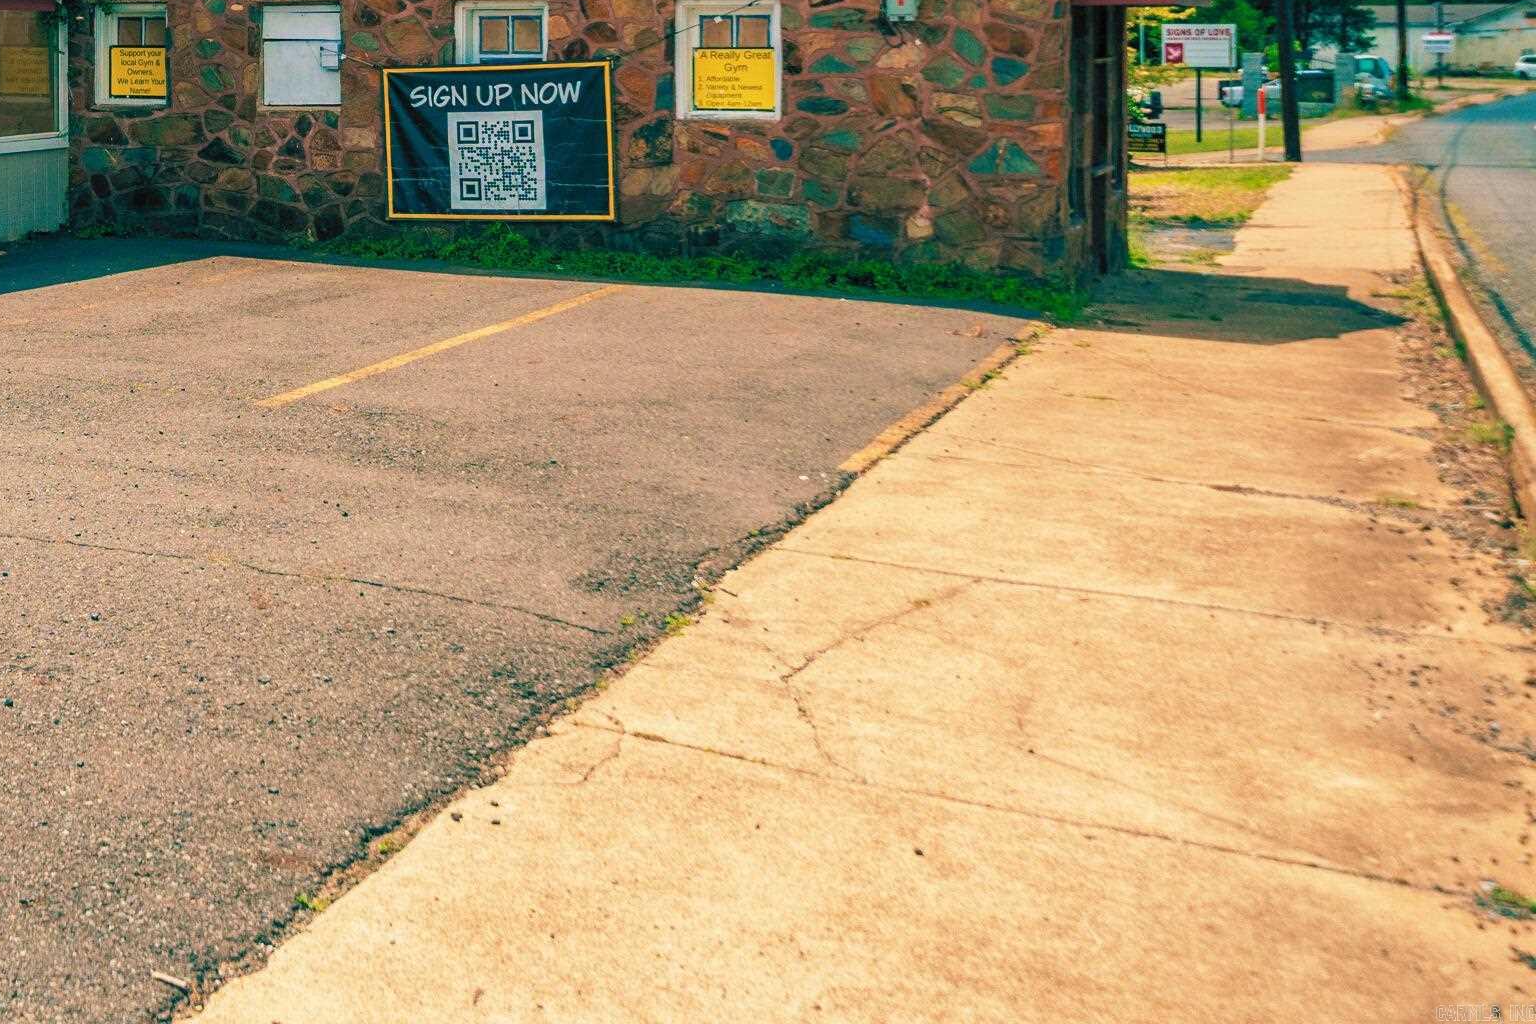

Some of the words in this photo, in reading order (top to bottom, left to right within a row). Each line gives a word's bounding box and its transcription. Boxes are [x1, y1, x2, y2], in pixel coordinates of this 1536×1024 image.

[1166, 28, 1192, 36] SIGNS
[1194, 28, 1205, 36] OF
[1207, 28, 1231, 36] LOVE
[119, 49, 147, 58] Support
[147, 50, 162, 59] your
[699, 51, 707, 60] A
[710, 50, 740, 61] Really
[743, 50, 771, 60] Great
[138, 59, 154, 68] Gym
[724, 63, 748, 74] Gym
[409, 85, 468, 108] SIGN
[476, 83, 513, 107] UP
[521, 80, 582, 106] NOW
